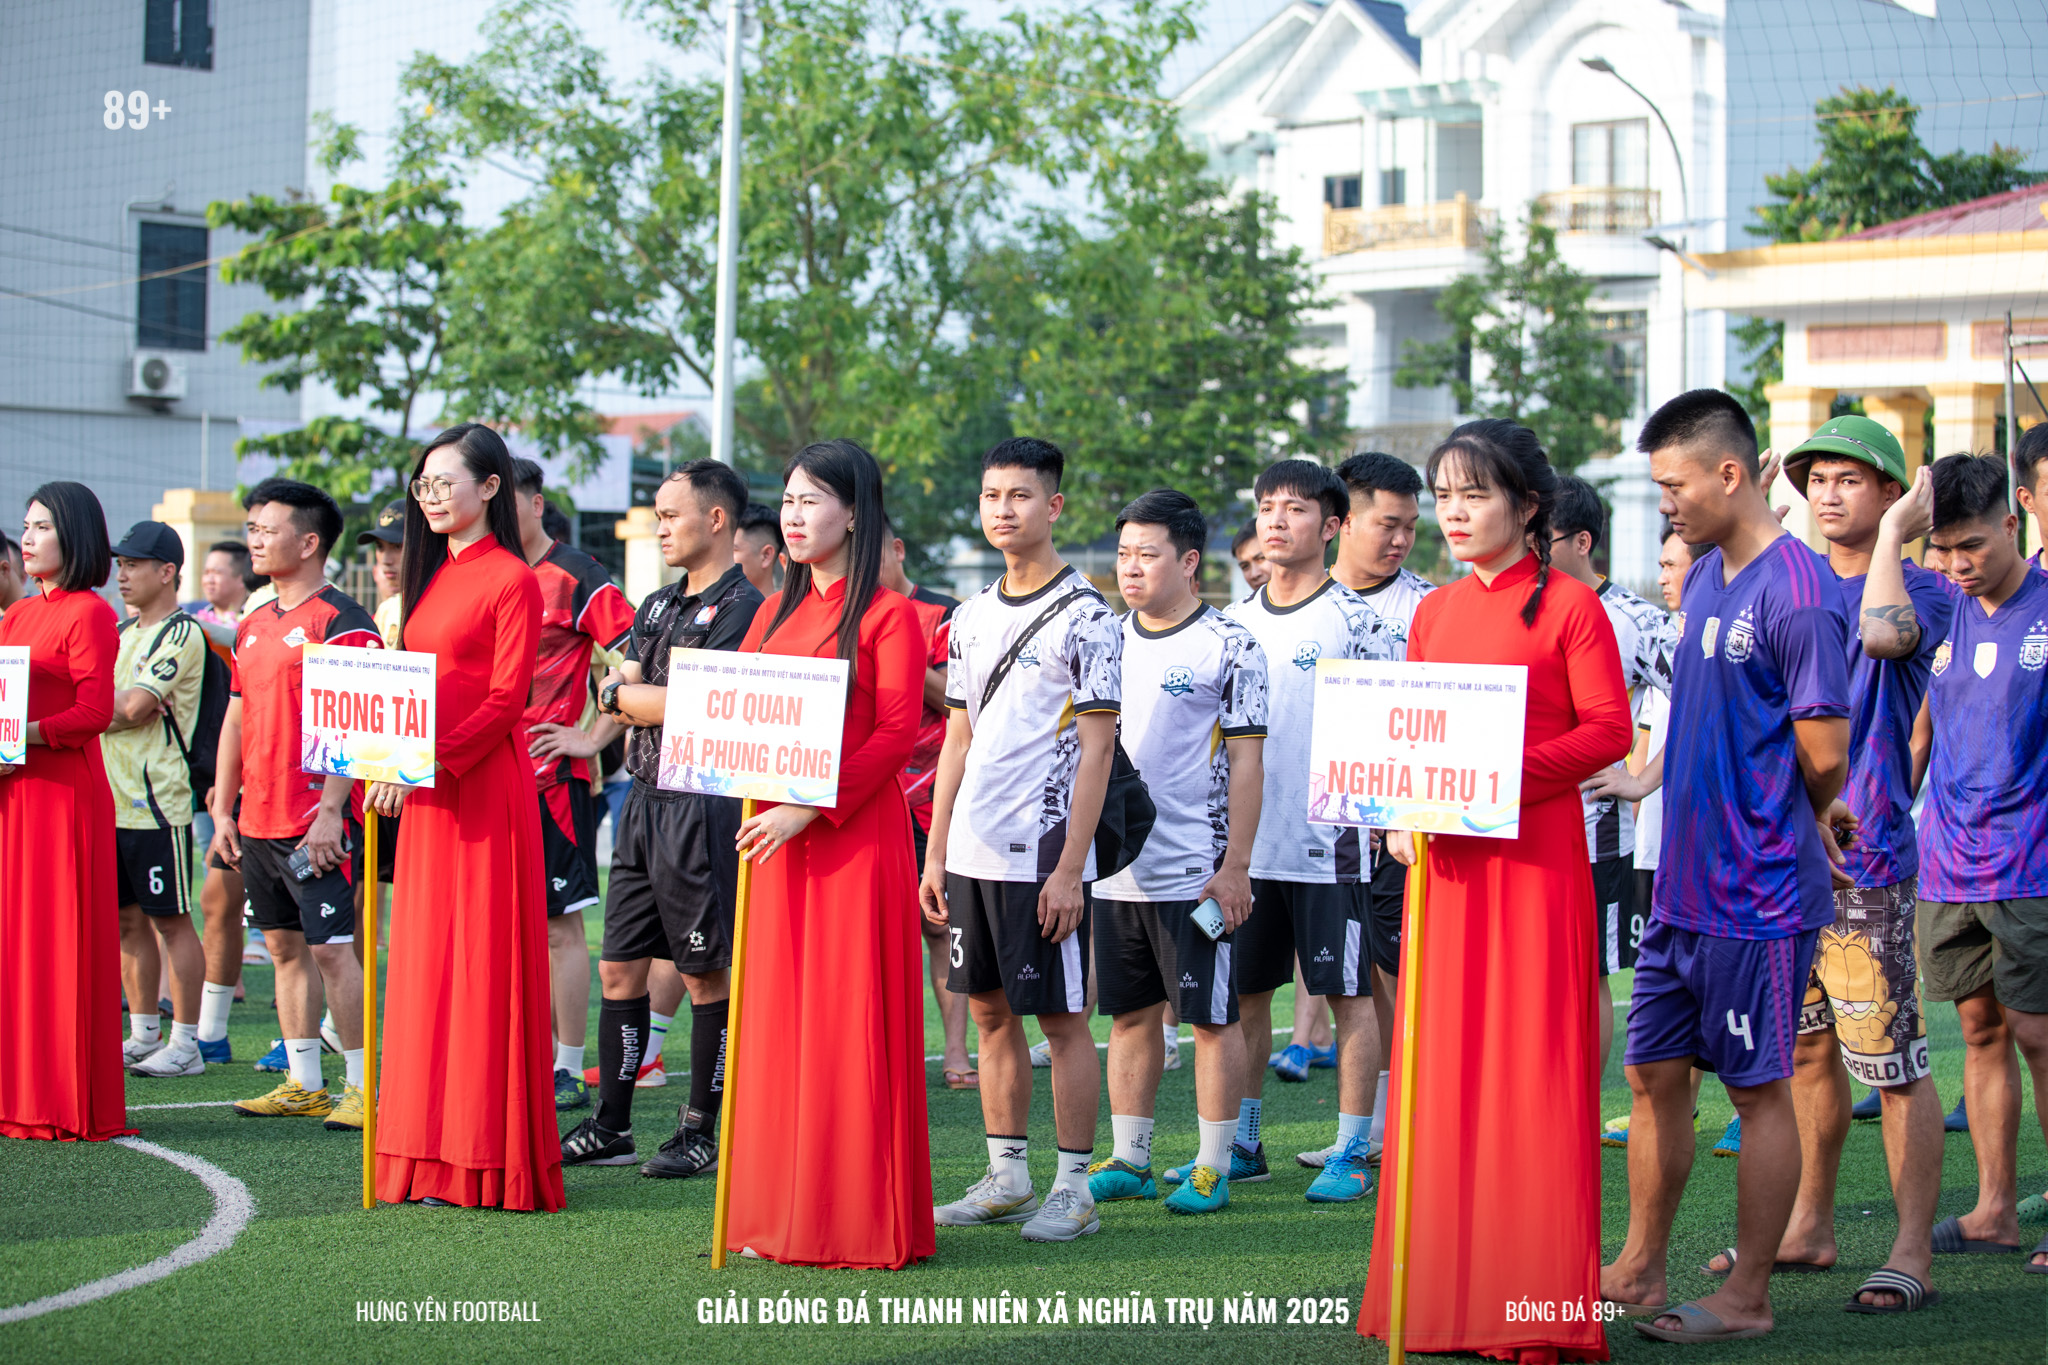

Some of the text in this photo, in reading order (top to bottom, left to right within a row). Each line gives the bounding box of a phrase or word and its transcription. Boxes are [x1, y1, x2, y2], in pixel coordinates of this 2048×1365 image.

[153, 661, 176, 677] hp
[749, 668, 760, 676] BAN
[789, 671, 802, 680] NAM
[310, 688, 427, 739] TRỌNG TÀI
[706, 688, 803, 726] CƠ QUAN
[1388, 707, 1447, 749] CỤM
[668, 730, 832, 780] XÃ PHỤNG CÔNG
[1328, 757, 1499, 810] NGHĨA TRỤ 1
[148, 865, 164, 895] 6
[949, 926, 964, 969] 3
[1629, 913, 1645, 949] 9
[1726, 1008, 1755, 1051] 4
[617, 1024, 639, 1081] JOGARBOLA
